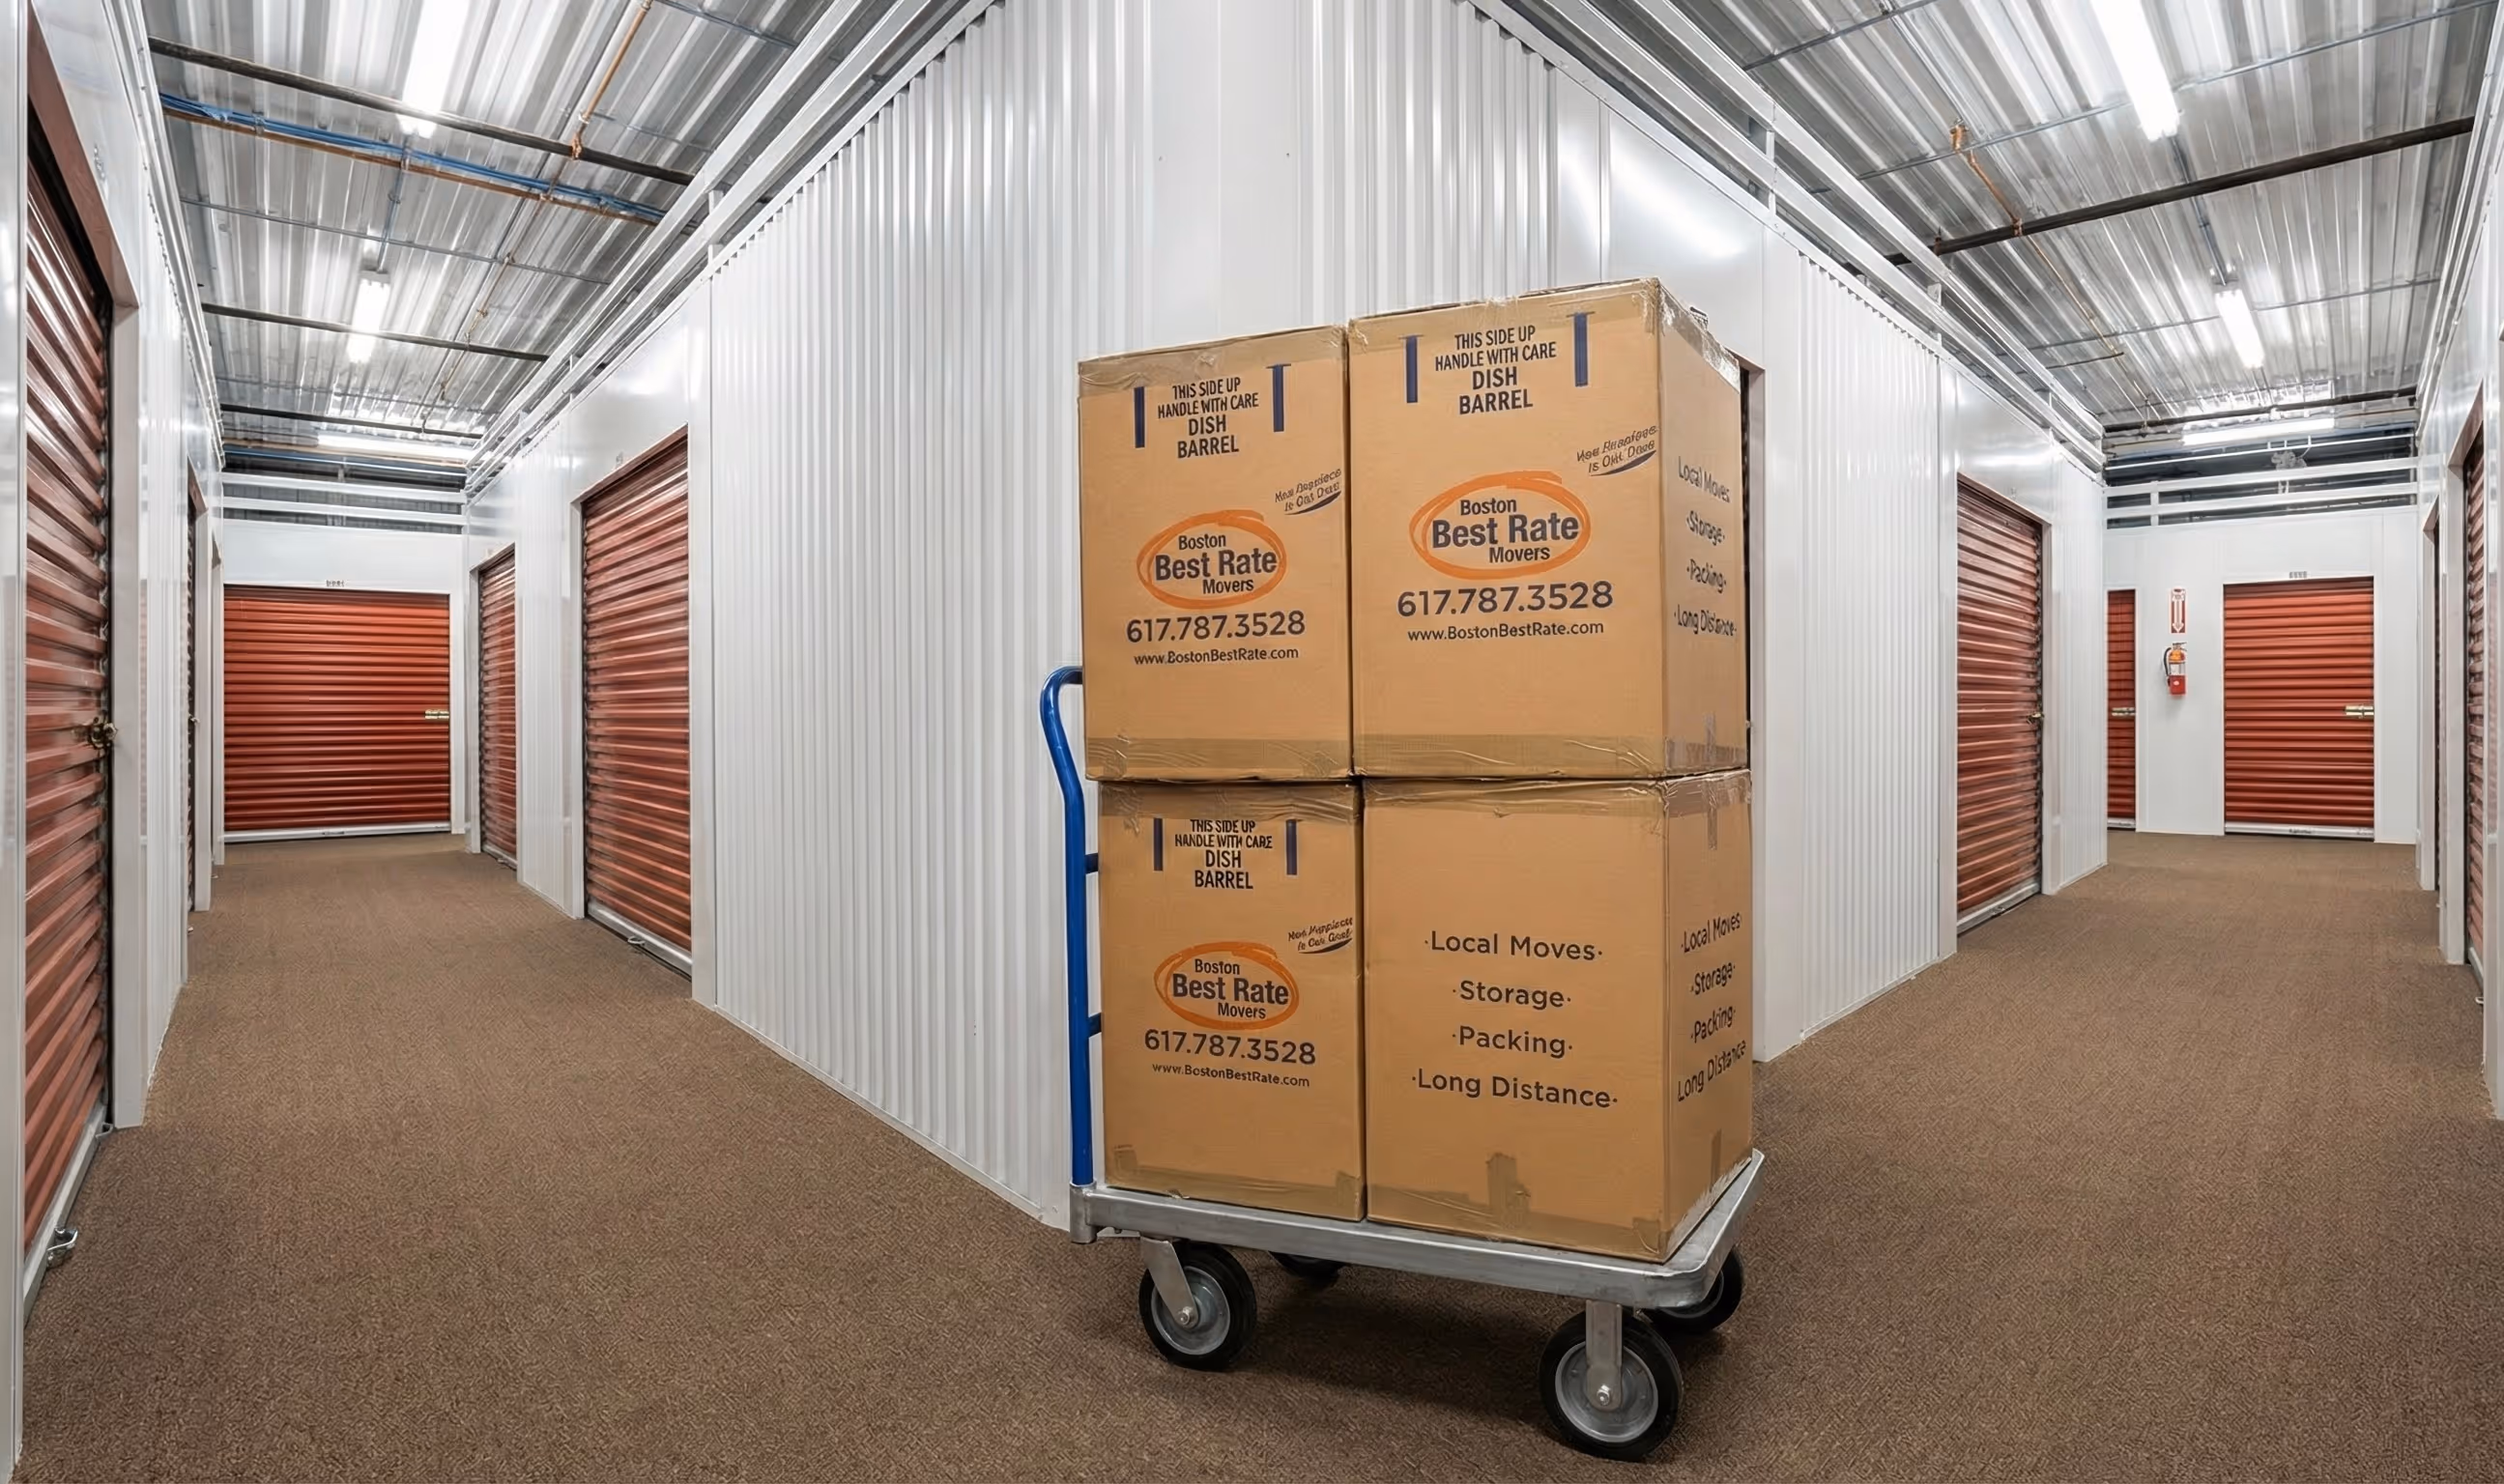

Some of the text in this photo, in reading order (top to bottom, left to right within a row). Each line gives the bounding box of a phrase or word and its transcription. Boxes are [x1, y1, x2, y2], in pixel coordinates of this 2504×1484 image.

[1454, 325, 1536, 350] THIS SIDE UP
[1435, 342, 1556, 371] HANDLE WITH CARE
[1172, 377, 1241, 400] THIS SIDE UP
[1472, 367, 1517, 390] DISH
[1158, 393, 1259, 418] HANDLE WITH CARE
[1458, 389, 1533, 414] BARREL
[1189, 414, 1226, 437] DISH
[1177, 435, 1239, 459] BARREL
[1460, 499, 1516, 515] Boston
[1432, 512, 1579, 549] Best Rate
[1179, 534, 1226, 551] Boston
[1155, 548, 1277, 581] Best Rate
[1489, 546, 1550, 563] Movers
[1203, 579, 1254, 594] Movers
[1397, 580, 1614, 616] 617.787.3528
[1127, 611, 1305, 642] 617.787.3528
[1408, 621, 1604, 641] www.BostonBestRate.com
[1135, 647, 1299, 665] www.BostonBestRate.com
[1191, 819, 1255, 833] THIS SIDE UP
[1175, 835, 1273, 849] HANDLE WITH CARE
[1205, 850, 1242, 869] DISH
[1194, 870, 1253, 890] BARREL
[1194, 958, 1240, 975] Boston
[1172, 974, 1289, 1005] Best Rate
[1218, 1003, 1266, 1019] Movers
[1144, 1029, 1316, 1065] 617.787.3528
[1152, 1063, 1310, 1087] www.BostonBestRate.com
[1678, 1070, 1704, 1102] Long
